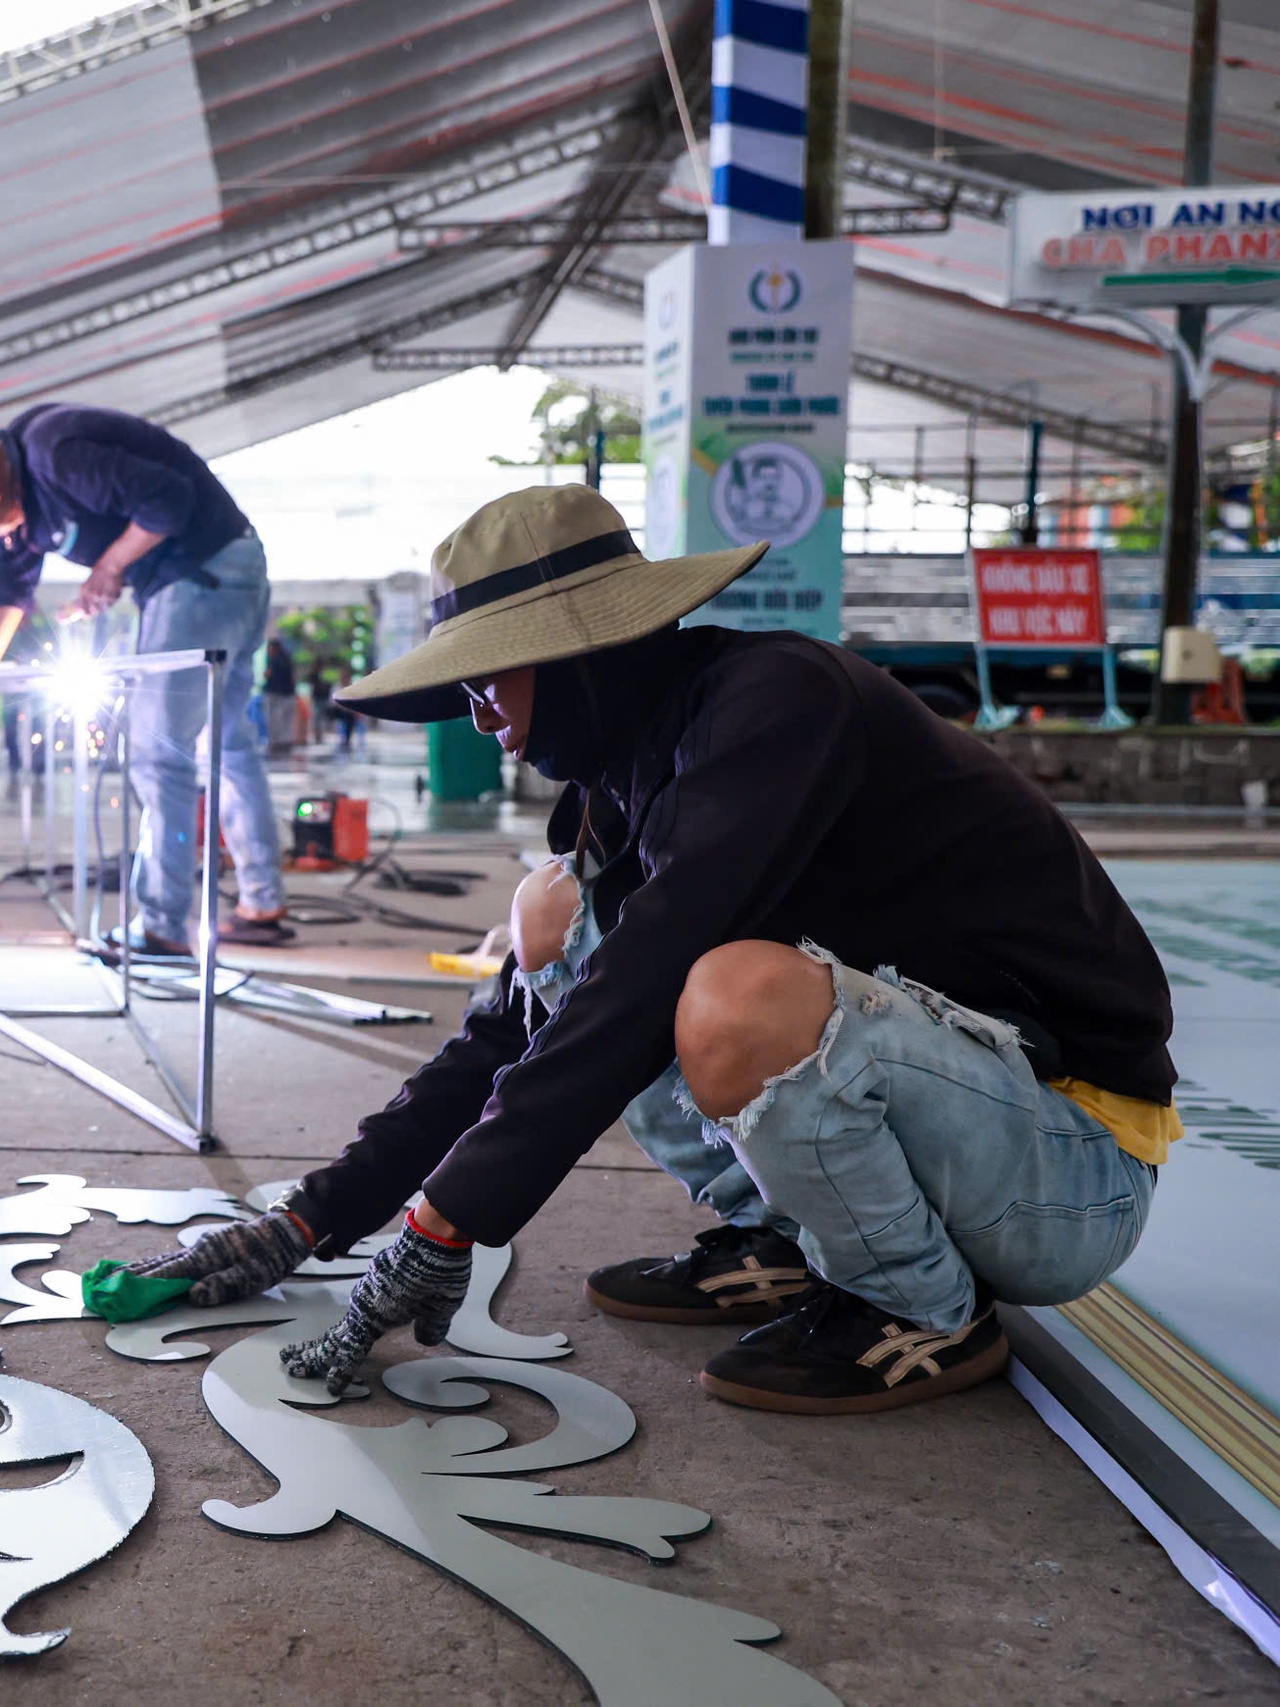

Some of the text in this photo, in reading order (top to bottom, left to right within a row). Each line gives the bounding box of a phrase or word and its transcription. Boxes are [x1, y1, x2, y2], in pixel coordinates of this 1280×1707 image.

[1171, 201, 1225, 227] AN
[1041, 231, 1280, 268] CHA PHAN
